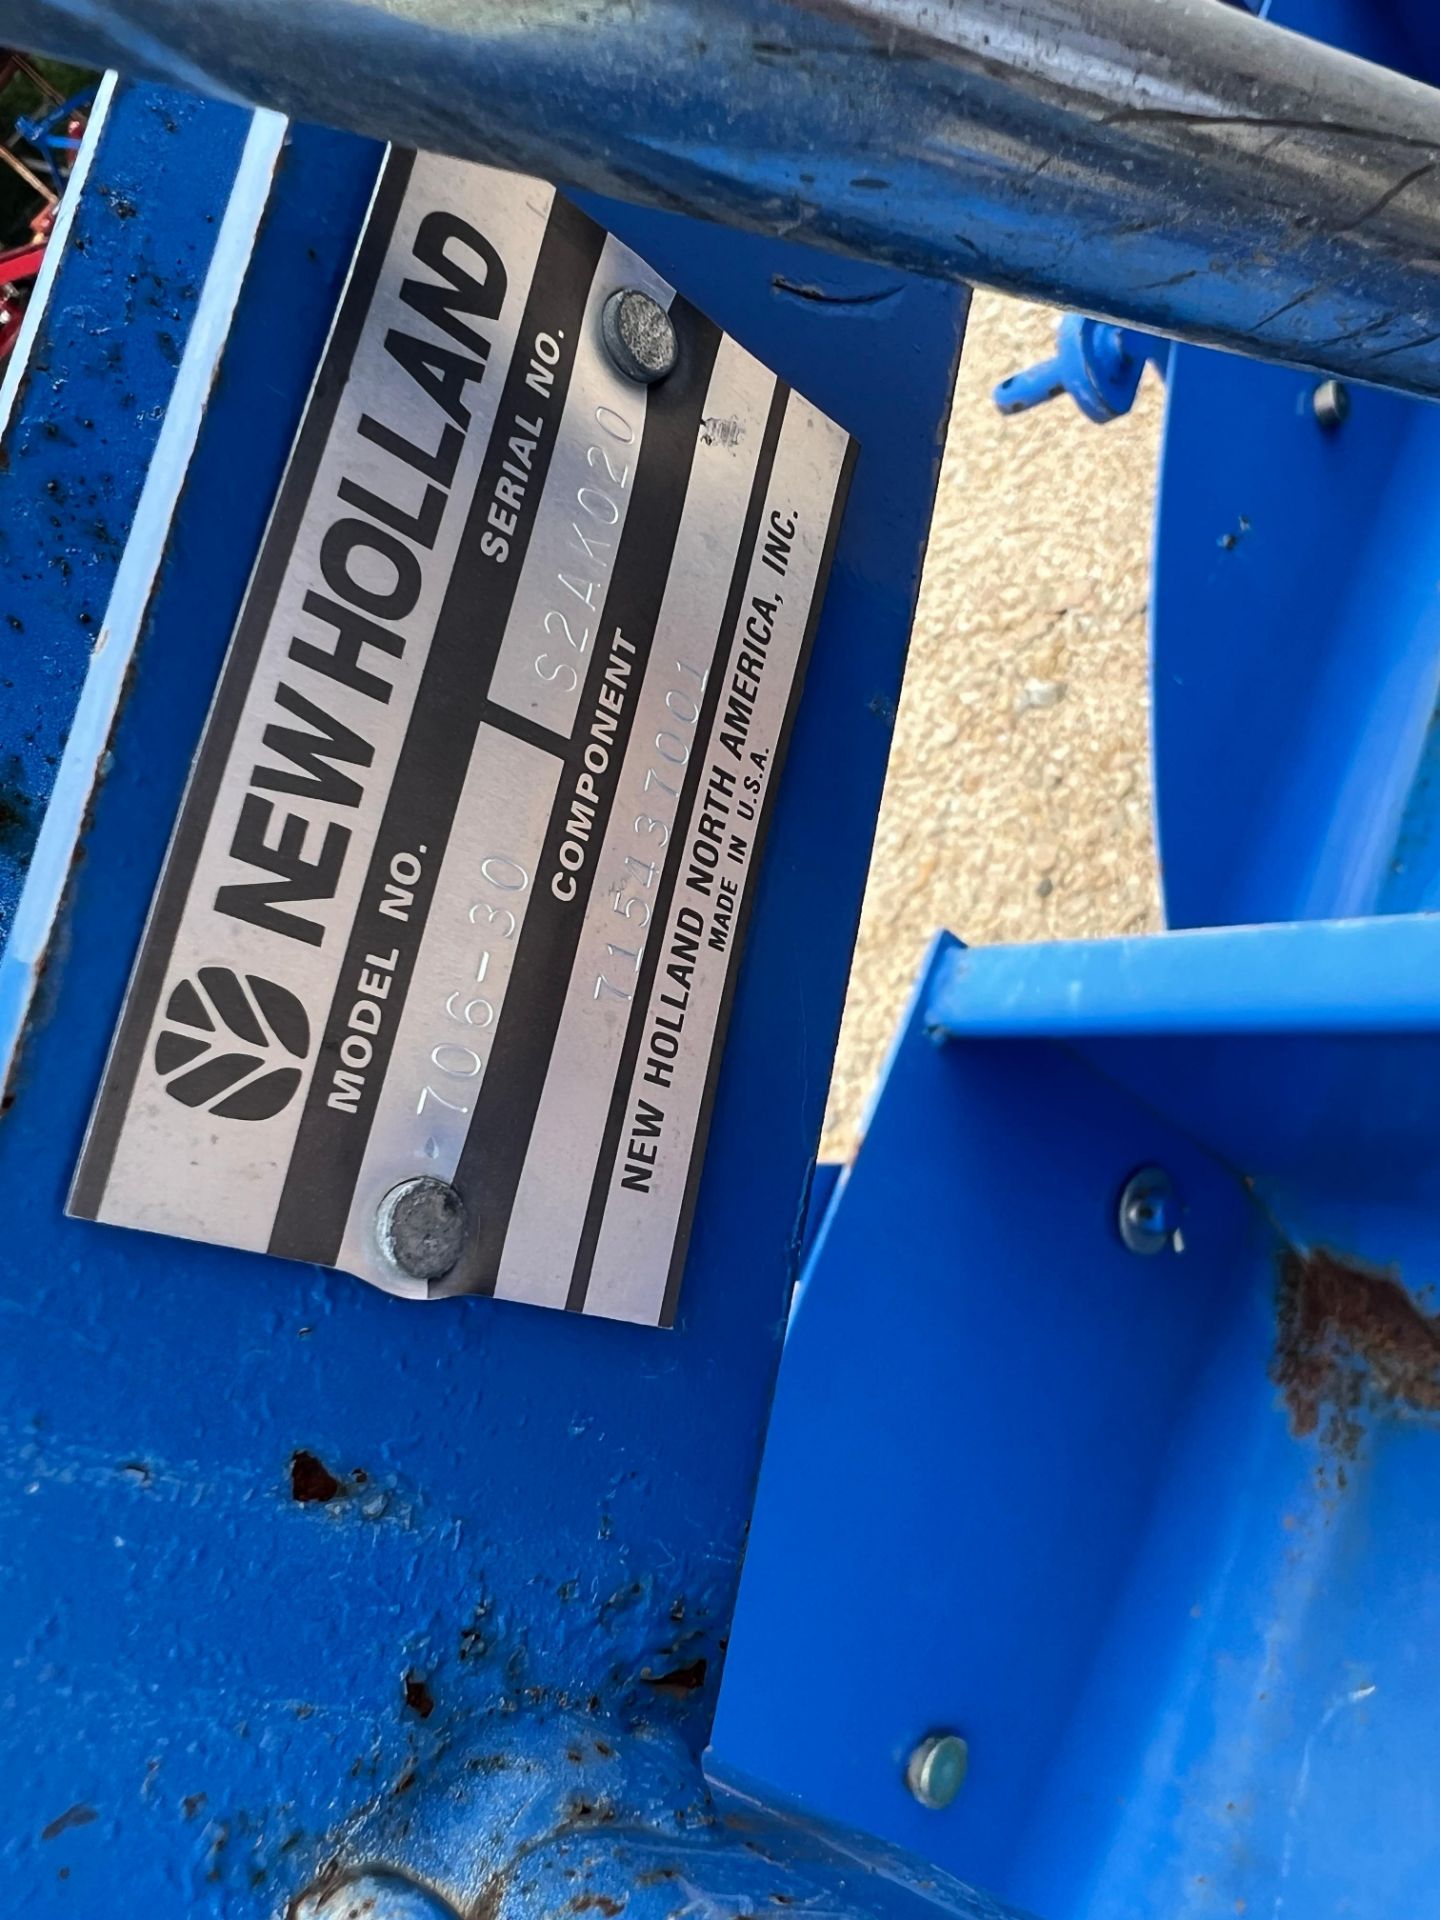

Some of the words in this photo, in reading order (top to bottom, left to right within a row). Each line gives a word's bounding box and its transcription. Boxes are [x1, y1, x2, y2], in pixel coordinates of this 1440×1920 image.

[288, 211, 507, 705] HOLLAND
[481, 415, 543, 563] SERIAL
[525, 329, 565, 398] NO.
[535, 406, 635, 692] S2AK020
[214, 682, 375, 947] NEW
[551, 627, 636, 901] COMPONENT
[594, 661, 709, 1000] 715437001
[621, 1099, 665, 1193] NEW
[644, 906, 704, 1088] HOLLAND
[685, 765, 736, 895] NORTH
[720, 594, 784, 760] AMERICA,
[762, 510, 798, 576] INC.
[708, 876, 738, 952] MADE
[727, 835, 747, 864] IN
[737, 748, 769, 821] U.S.A.
[328, 948, 399, 1113] MODEL
[379, 844, 427, 921] NO.
[417, 856, 528, 1115] 706-30
